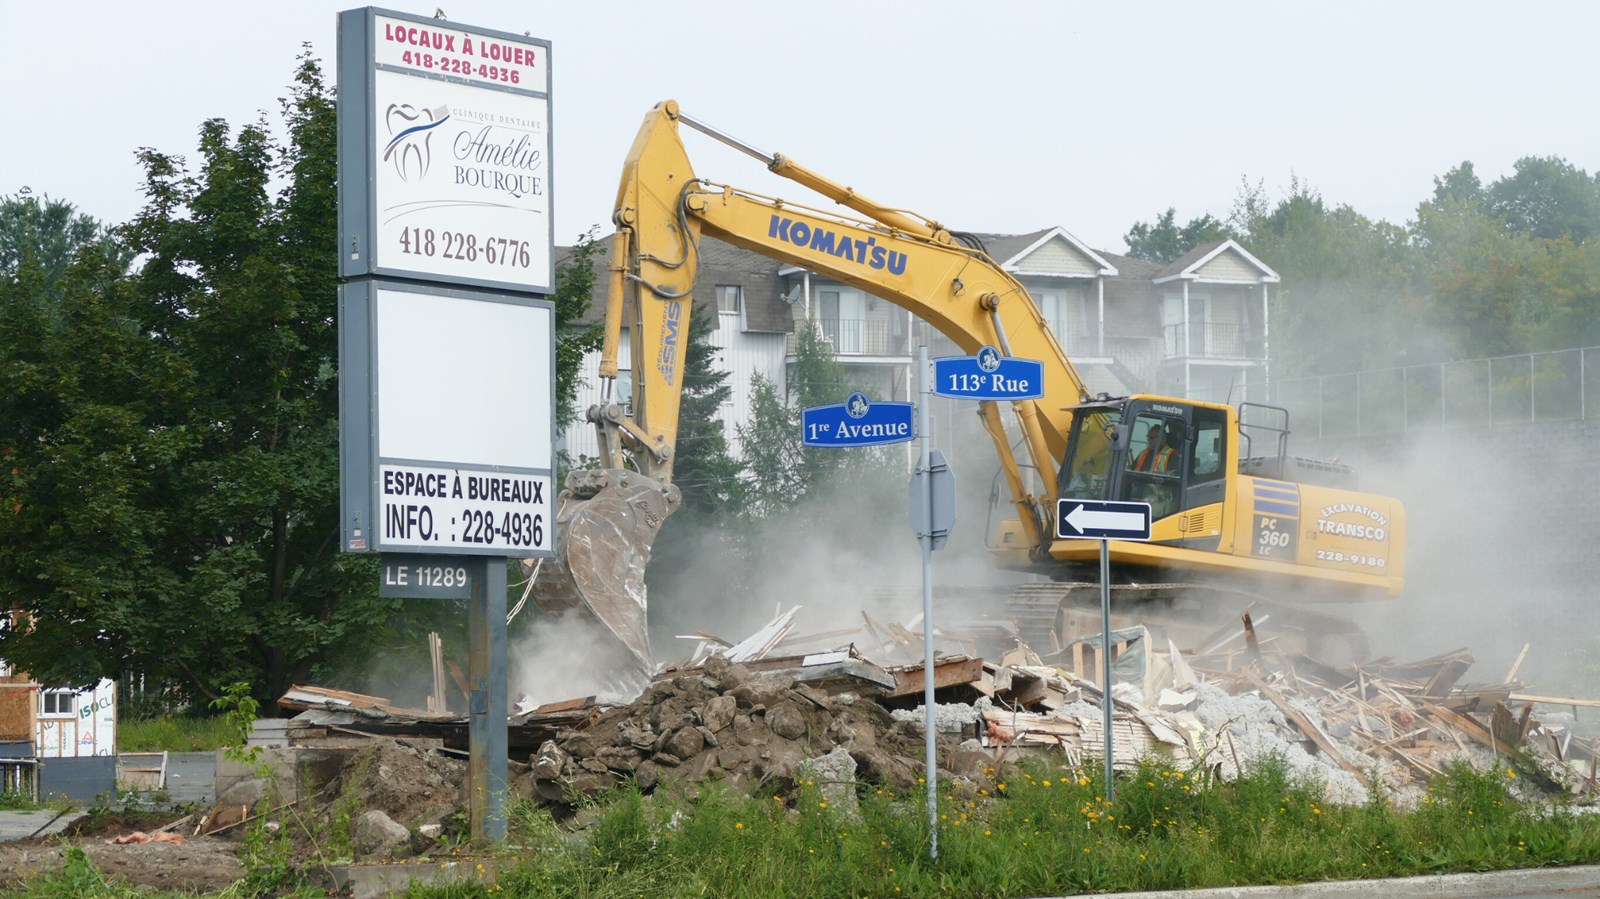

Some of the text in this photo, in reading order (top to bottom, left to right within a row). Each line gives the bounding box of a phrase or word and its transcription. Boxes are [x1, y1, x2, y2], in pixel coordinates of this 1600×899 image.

[385, 23, 535, 68] LOCAUX À LOUER
[402, 51, 520, 84] 418-228-4936
[452, 108, 541, 129] CLINIQUE DENTAIRE
[453, 126, 541, 171] Amélie
[454, 165, 542, 198] BOURQUE
[399, 226, 530, 269] 418 228-6776
[768, 214, 908, 276] KOMATSU
[663, 301, 681, 365] SMS
[949, 370, 1029, 392] 113e Rue
[1152, 403, 1183, 415] KOMATSU
[808, 421, 908, 440] 1re Avenue
[384, 469, 544, 505] ESPACE À BUREAUX
[386, 503, 439, 541] INFO.
[462, 509, 543, 547] 228-4936
[1260, 517, 1277, 530] PC
[1320, 503, 1388, 526] EXCAVATION
[1259, 530, 1290, 547] 360
[1317, 519, 1385, 541] TRANSCO
[1259, 546, 1271, 556] LC
[1316, 550, 1386, 568] 228-9180
[386, 566, 467, 588] LE 11289
